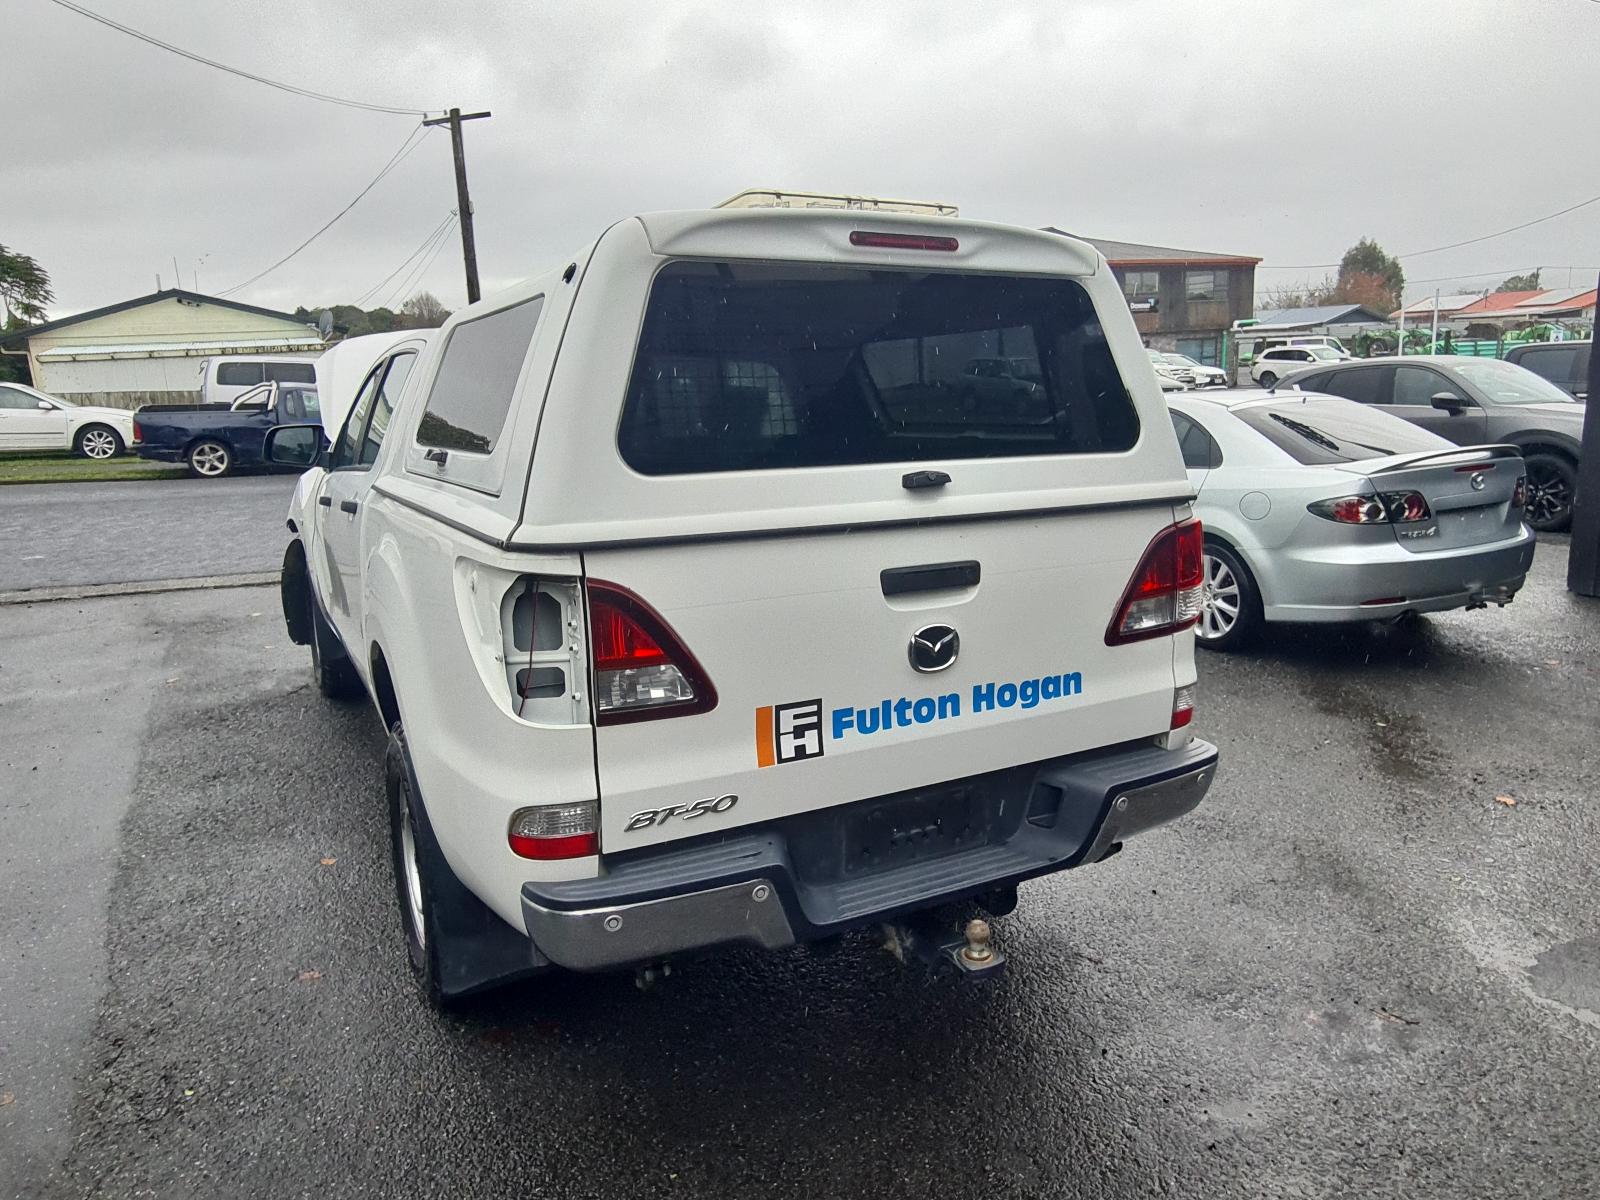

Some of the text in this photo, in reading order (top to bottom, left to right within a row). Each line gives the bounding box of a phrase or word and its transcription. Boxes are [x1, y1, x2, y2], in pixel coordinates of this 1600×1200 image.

[832, 671, 1083, 740] Fulton Hogan
[624, 793, 739, 832] BT-50
